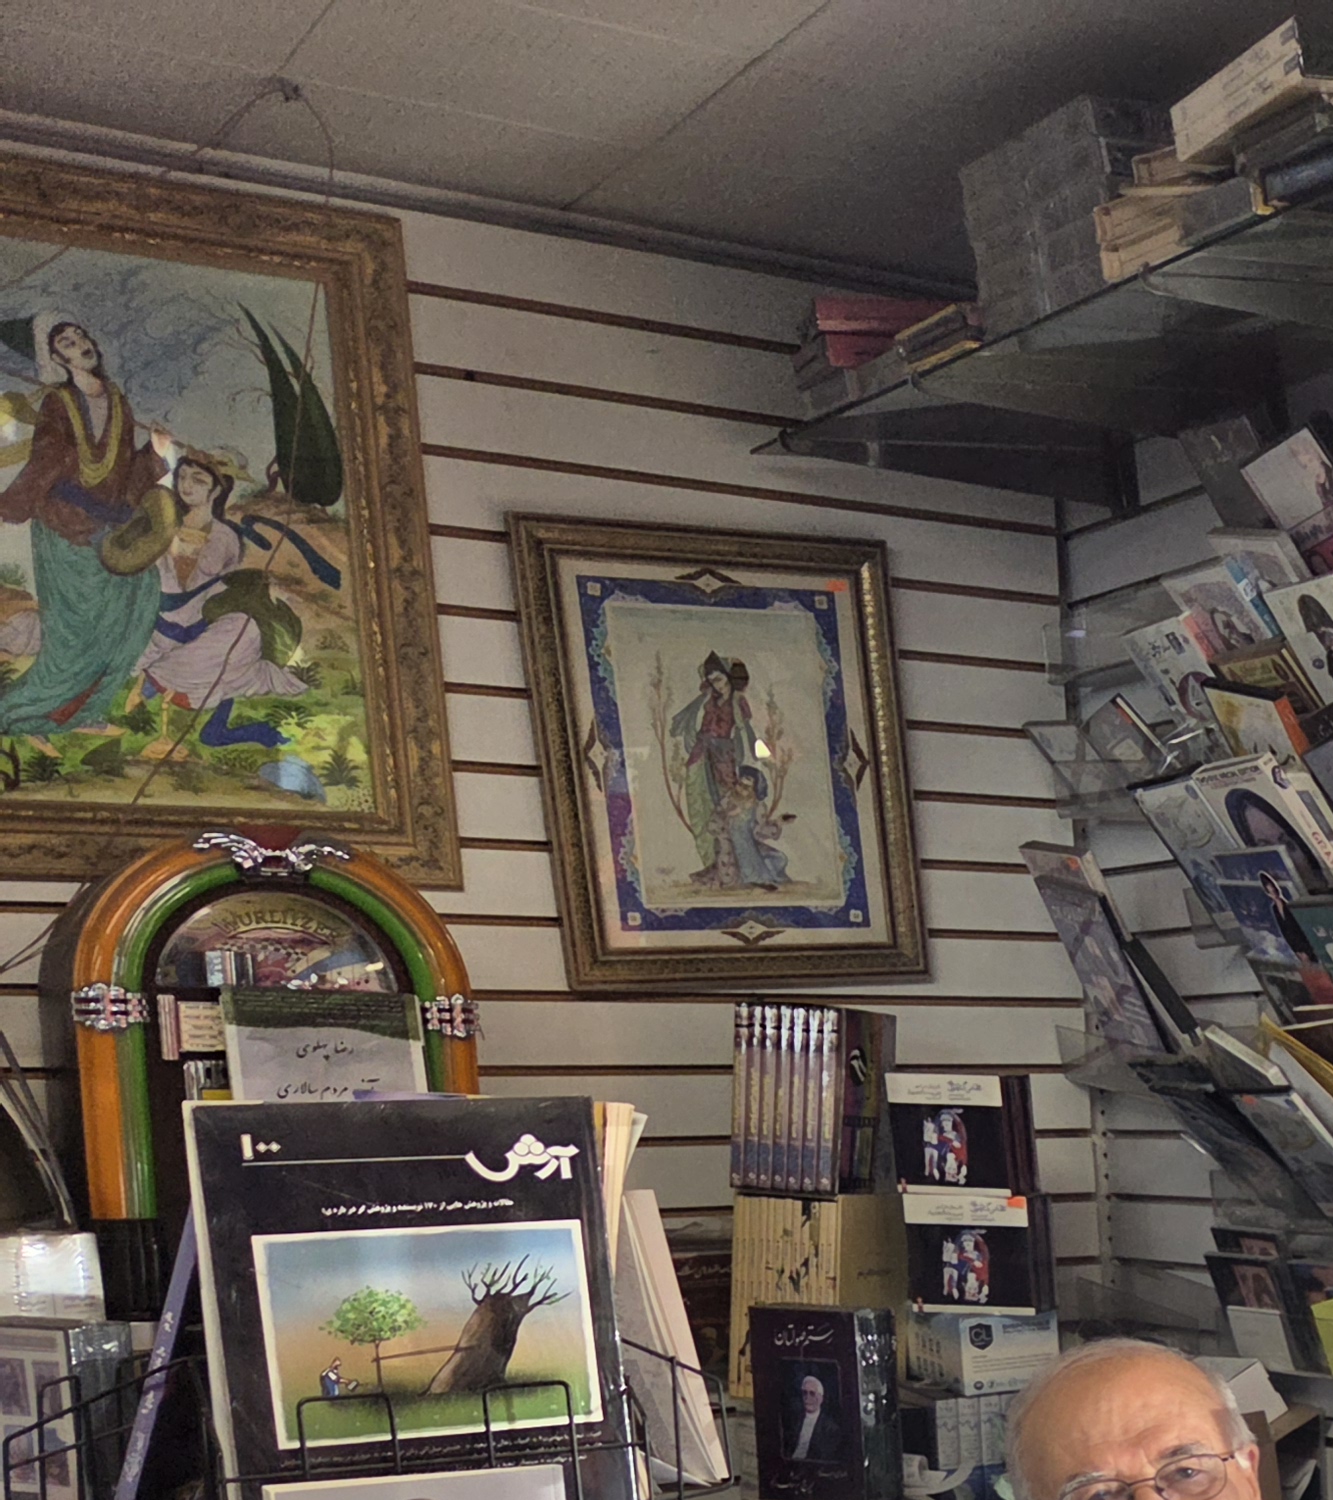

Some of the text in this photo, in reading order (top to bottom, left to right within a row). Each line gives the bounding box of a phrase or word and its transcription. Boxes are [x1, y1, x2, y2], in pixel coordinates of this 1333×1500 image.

[296, 1039, 328, 1061] پهلوی
[277, 1080, 349, 1099] مردم سالاری
[464, 1133, 581, 1183] آرش
